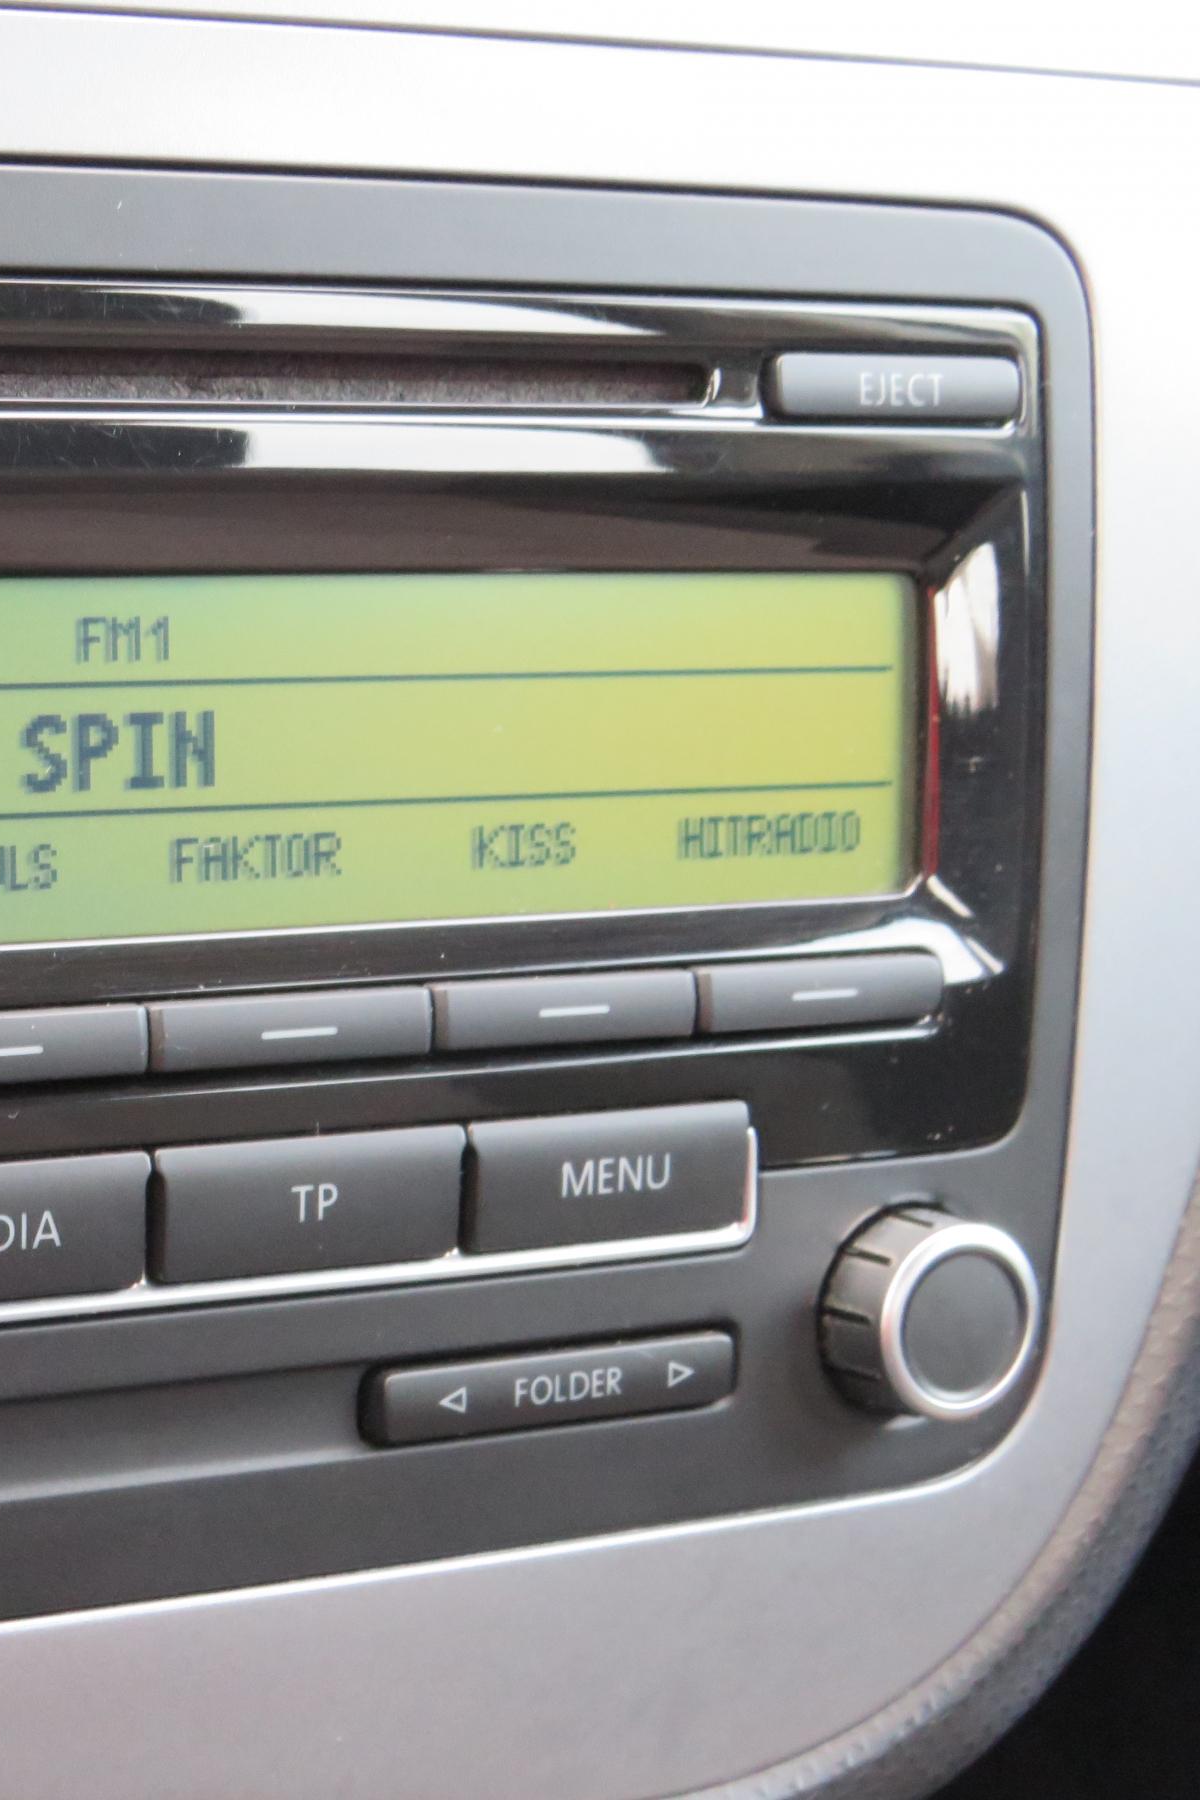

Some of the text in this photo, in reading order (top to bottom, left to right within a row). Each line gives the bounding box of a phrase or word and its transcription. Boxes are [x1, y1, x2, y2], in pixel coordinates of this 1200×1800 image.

[859, 373, 944, 407] EJECT
[76, 616, 170, 663] FM1
[21, 710, 215, 793] SPIN
[170, 832, 341, 883] FAKTOR
[472, 822, 576, 869] KISS
[678, 811, 860, 860] HITRADIO
[560, 1153, 672, 1198] MENU
[291, 1183, 339, 1222] TP
[514, 1367, 622, 1407] FOLDER
